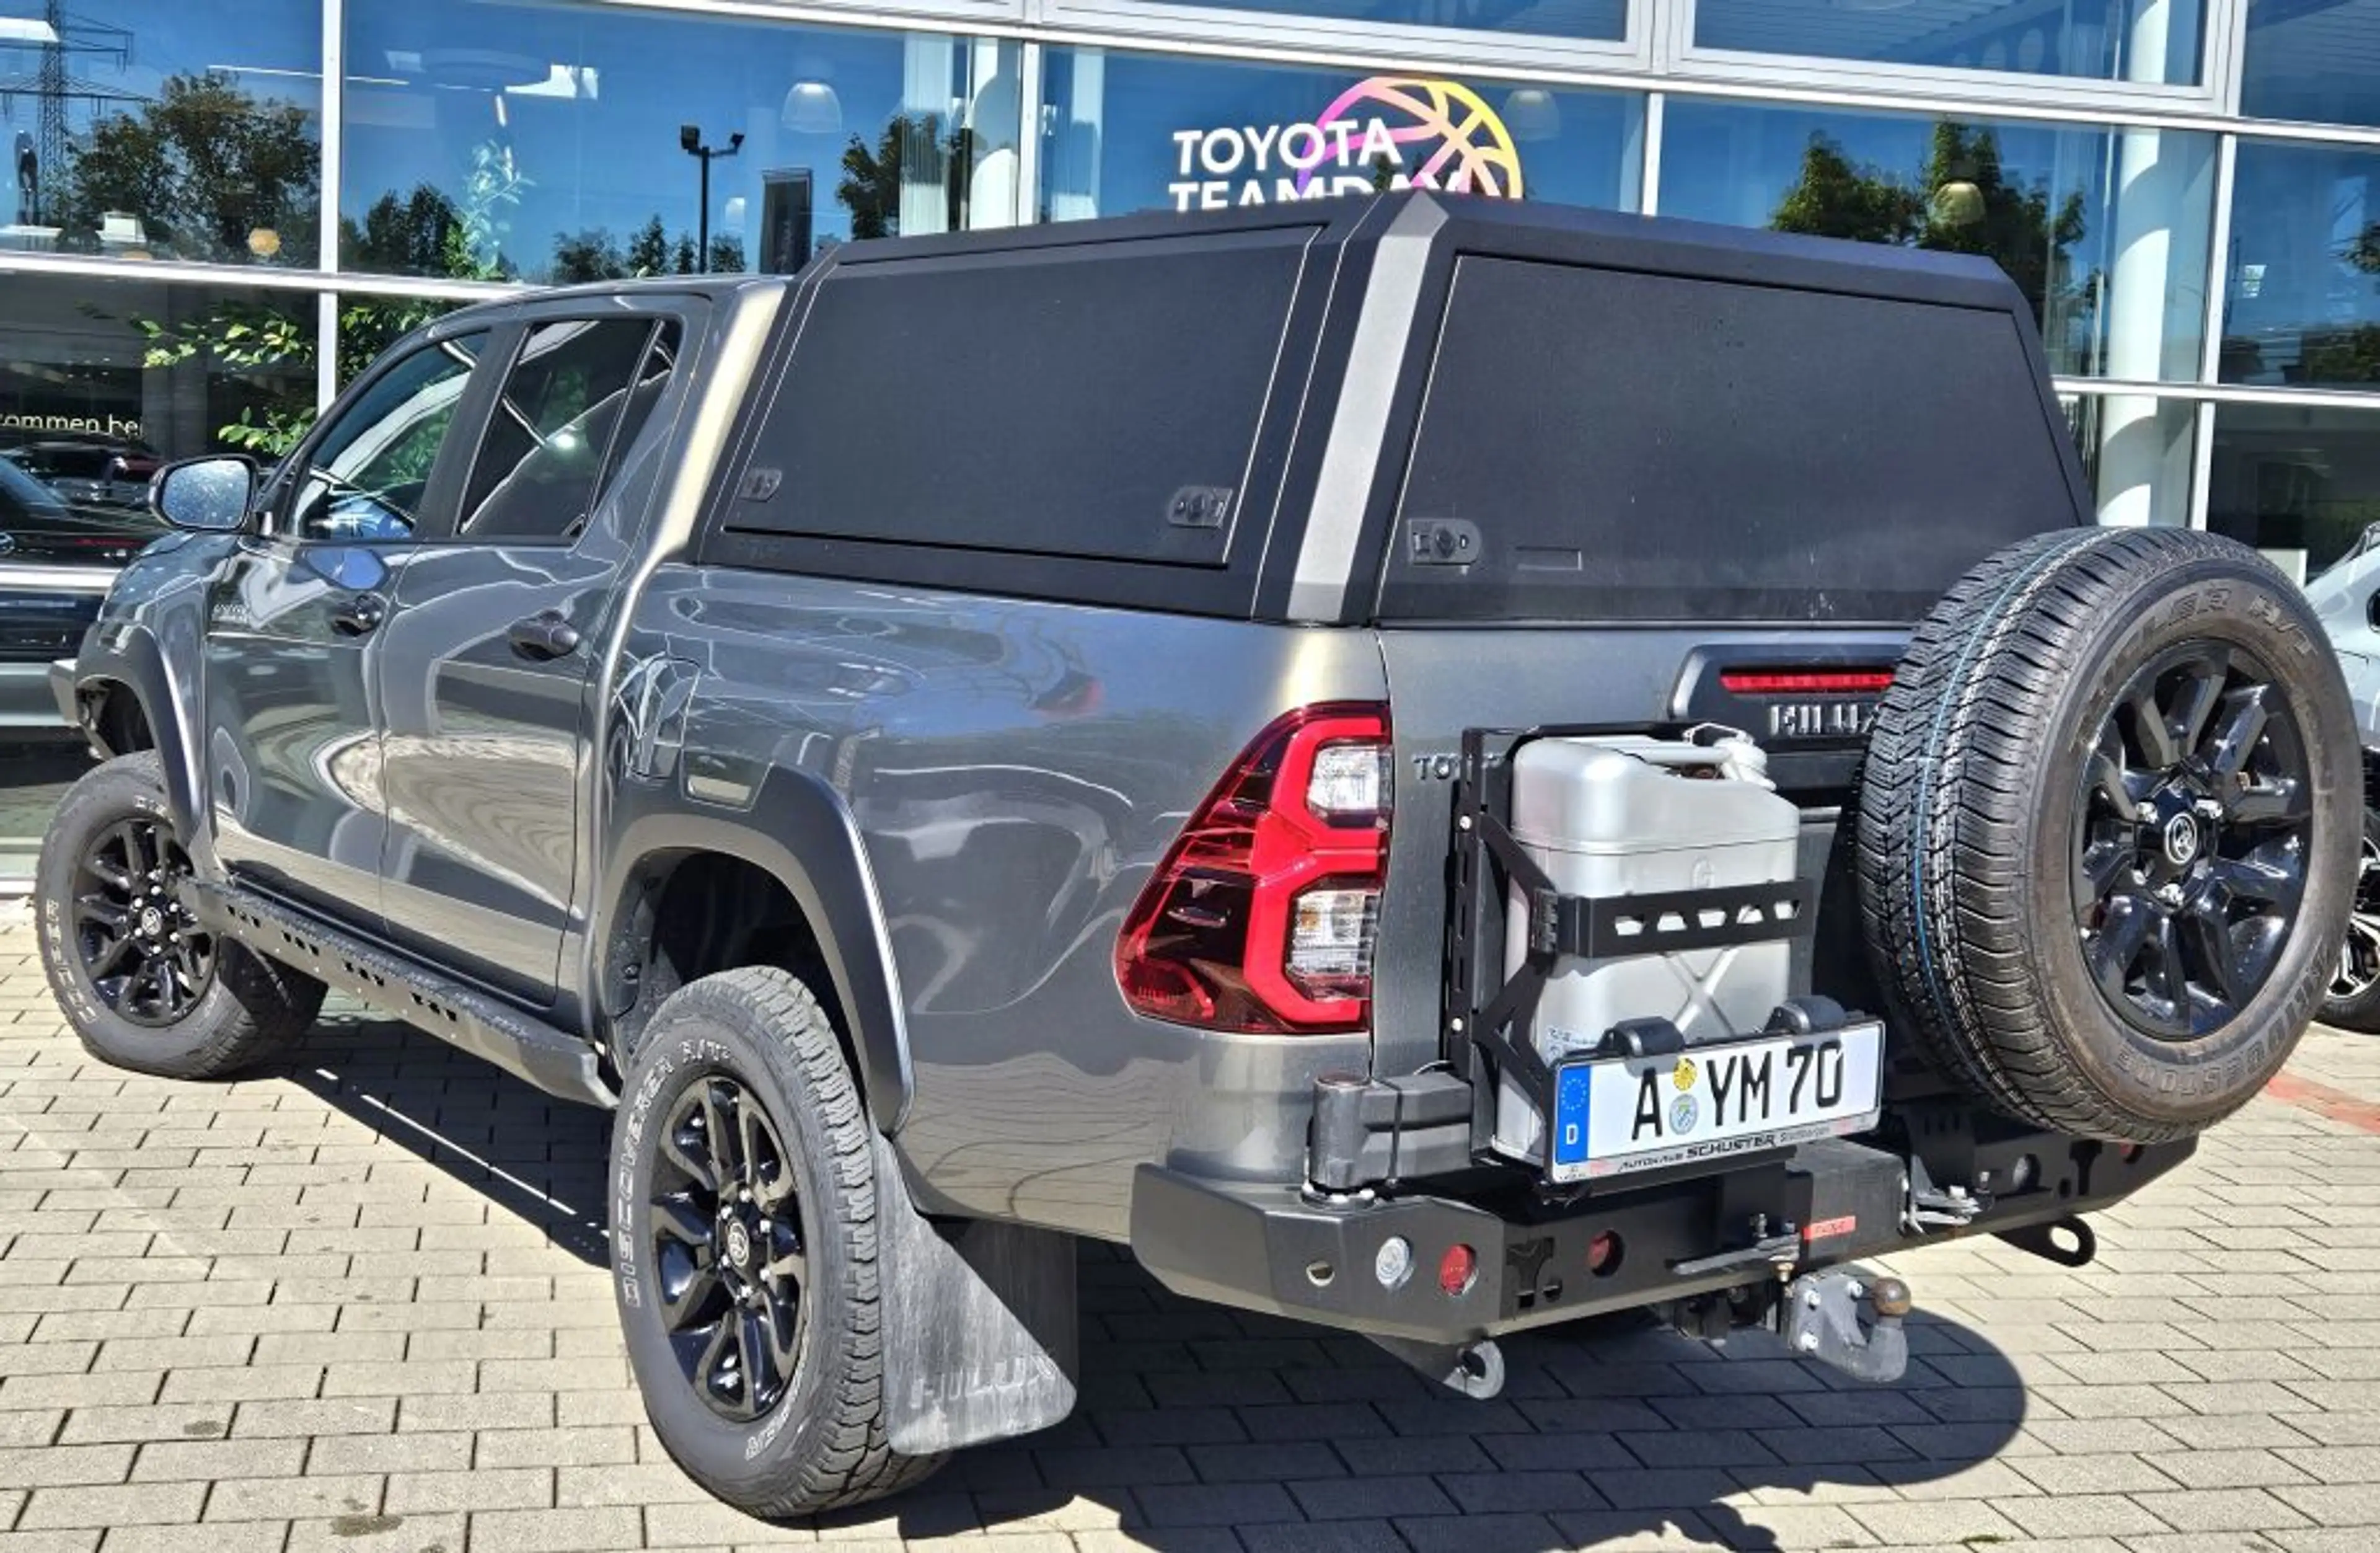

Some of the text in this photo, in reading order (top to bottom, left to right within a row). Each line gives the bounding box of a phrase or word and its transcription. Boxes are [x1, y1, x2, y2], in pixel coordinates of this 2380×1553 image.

[1173, 117, 1403, 176] TOYOTA
[1631, 1039, 1843, 1140] A YM 70
[1566, 1124, 1579, 1145] D
[1686, 1135, 1776, 1160] SCHUSTER
[618, 1056, 674, 1307] DISCOVERER
